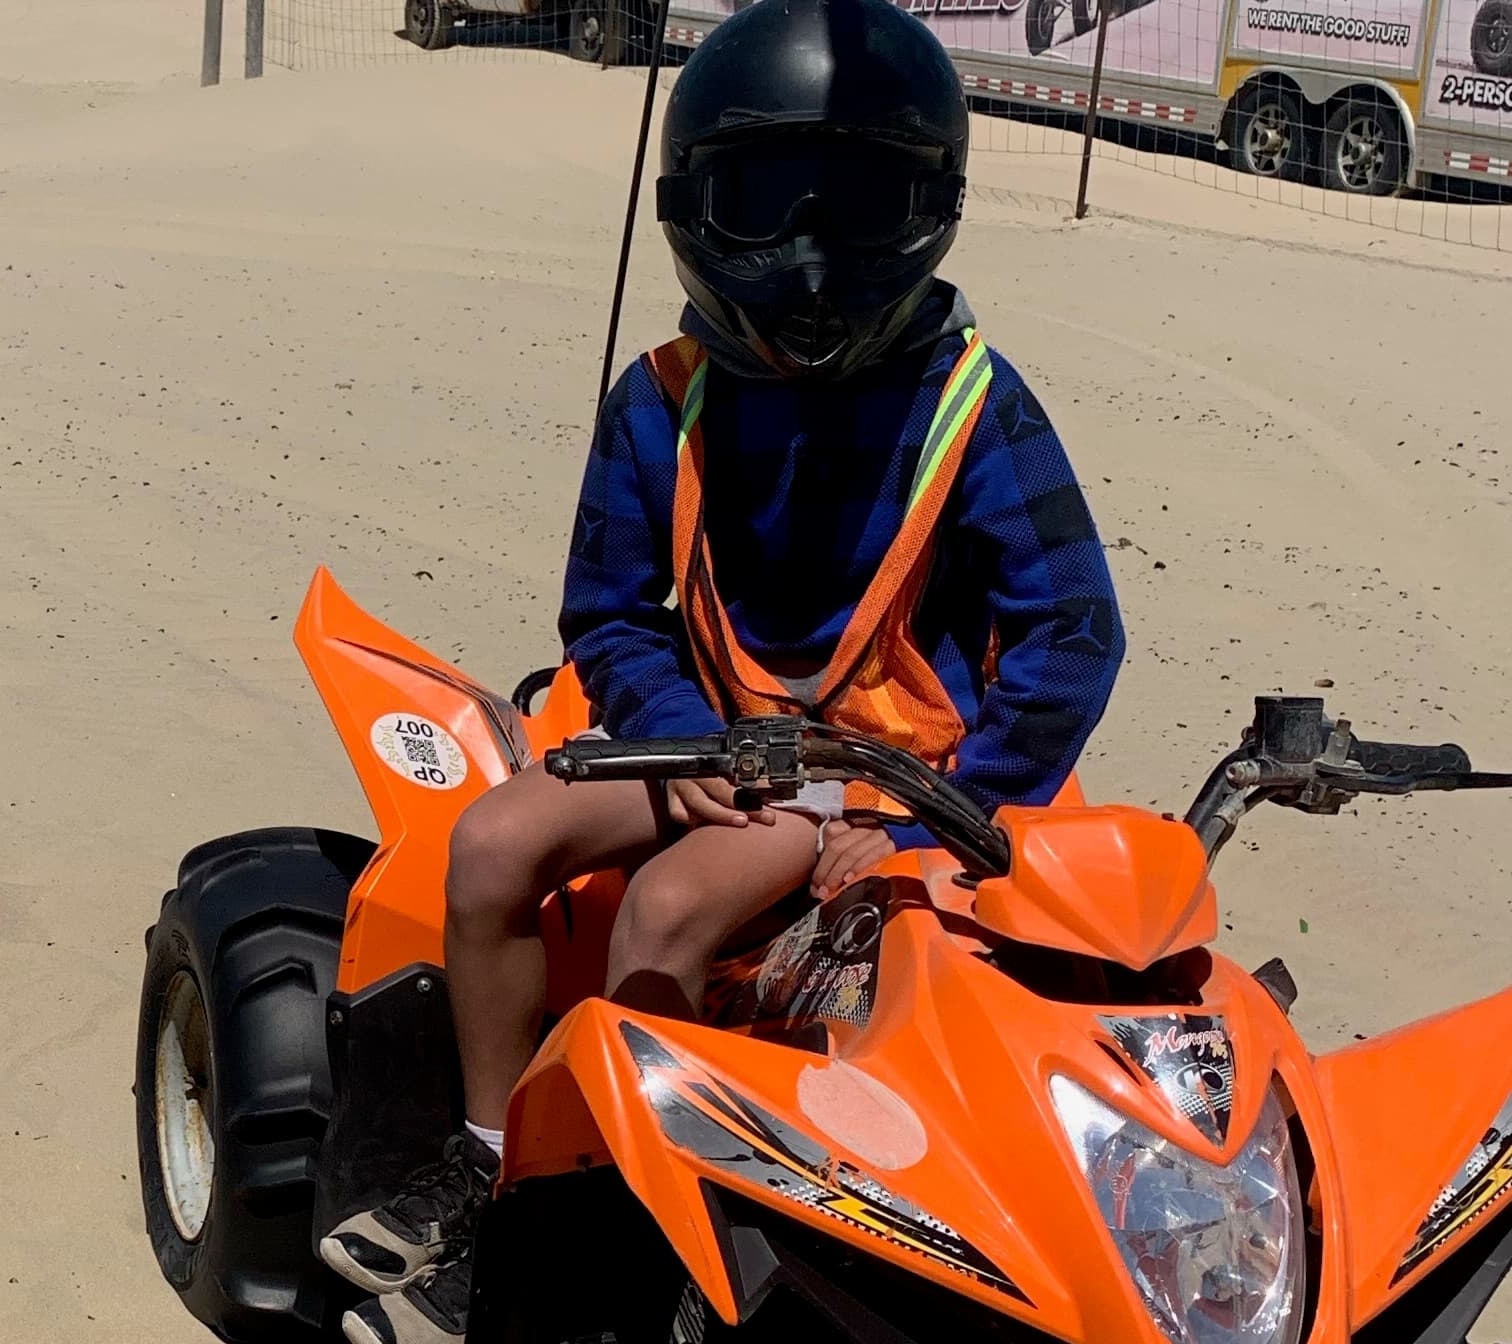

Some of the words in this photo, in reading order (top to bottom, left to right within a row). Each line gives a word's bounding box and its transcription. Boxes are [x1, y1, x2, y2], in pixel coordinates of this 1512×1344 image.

[1248, 8, 1268, 28] WE
[1268, 10, 1300, 31] RENT
[1300, 13, 1324, 35] THE
[1324, 15, 1366, 40] GOOD
[1366, 21, 1410, 46] STUFF!
[395, 720, 433, 737] 007
[414, 767, 446, 784] QP
